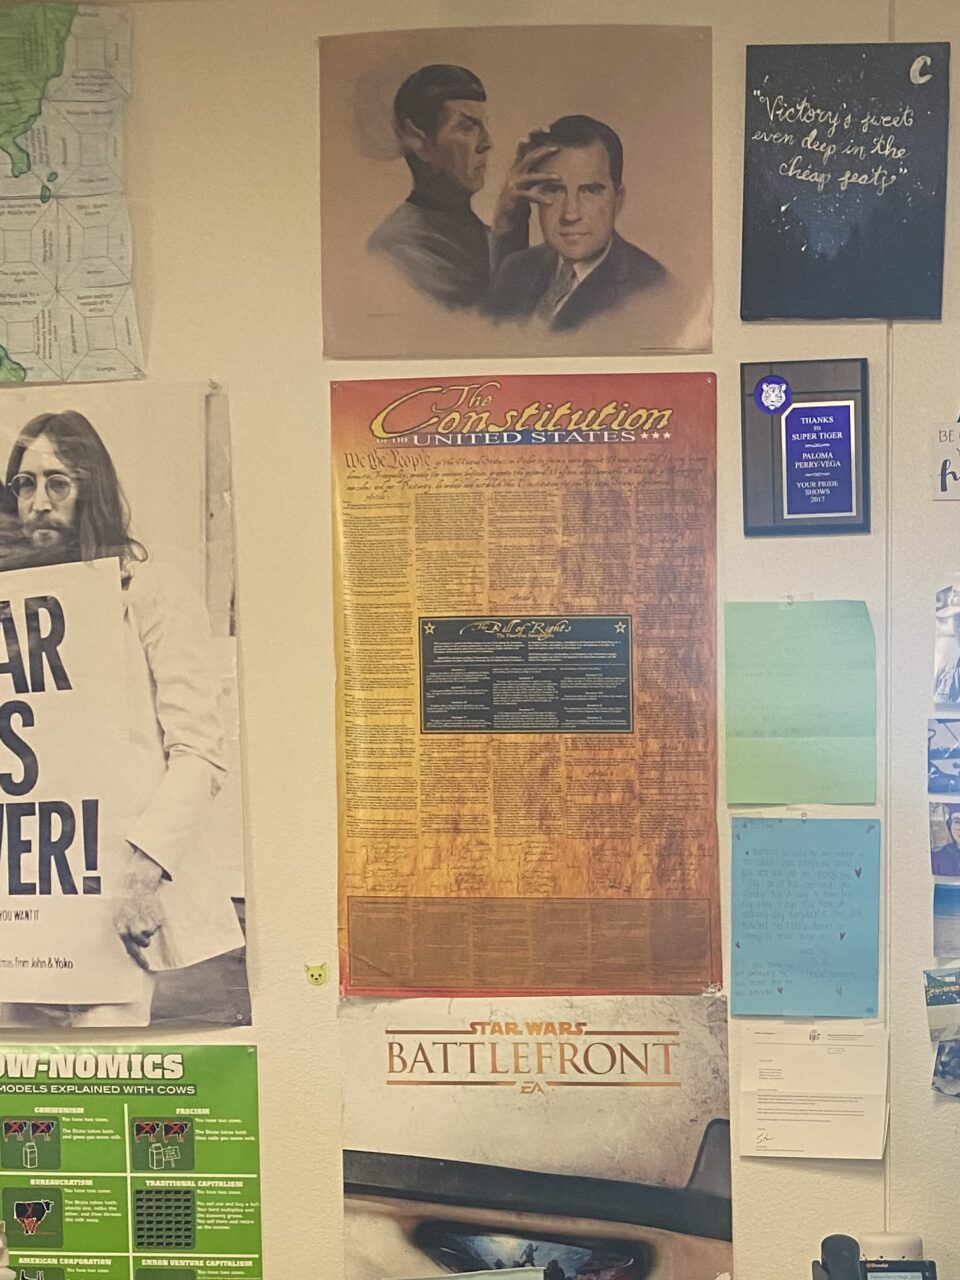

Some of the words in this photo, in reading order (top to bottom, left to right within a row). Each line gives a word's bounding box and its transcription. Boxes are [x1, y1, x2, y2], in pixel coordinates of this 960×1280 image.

[861, 104, 914, 133] sweet
[752, 130, 794, 146] even
[801, 129, 836, 164] deep
[842, 139, 866, 160] in
[870, 135, 909, 159] the
[779, 156, 831, 192] cheap
[432, 382, 500, 413] The
[369, 385, 674, 440] Constitution
[800, 416, 834, 424] THANKS
[413, 432, 522, 446] UNITED
[531, 431, 636, 444] STATES
[792, 432, 817, 441] SUPER
[818, 431, 843, 440] TIGER
[939, 430, 954, 442] BE
[802, 452, 833, 460] PALOMA
[795, 460, 841, 469] PERRY-VEGA
[805, 488, 830, 496] SHOWS
[0, 799, 101, 895] ER!
[14, 910, 32, 920] WANT
[34, 909, 39, 920] IT
[469, 1022, 523, 1035] STAR
[525, 1022, 587, 1035] WARS
[387, 1041, 680, 1074] BATTLEFRONT
[0, 1053, 184, 1080] W-NOMICS
[50, 1085, 120, 1094] EXPLAINED
[123, 1085, 155, 1094] WITH
[157, 1085, 195, 1095] COWS
[519, 1081, 544, 1094] EA
[170, 1259, 204, 1267] VENTURE
